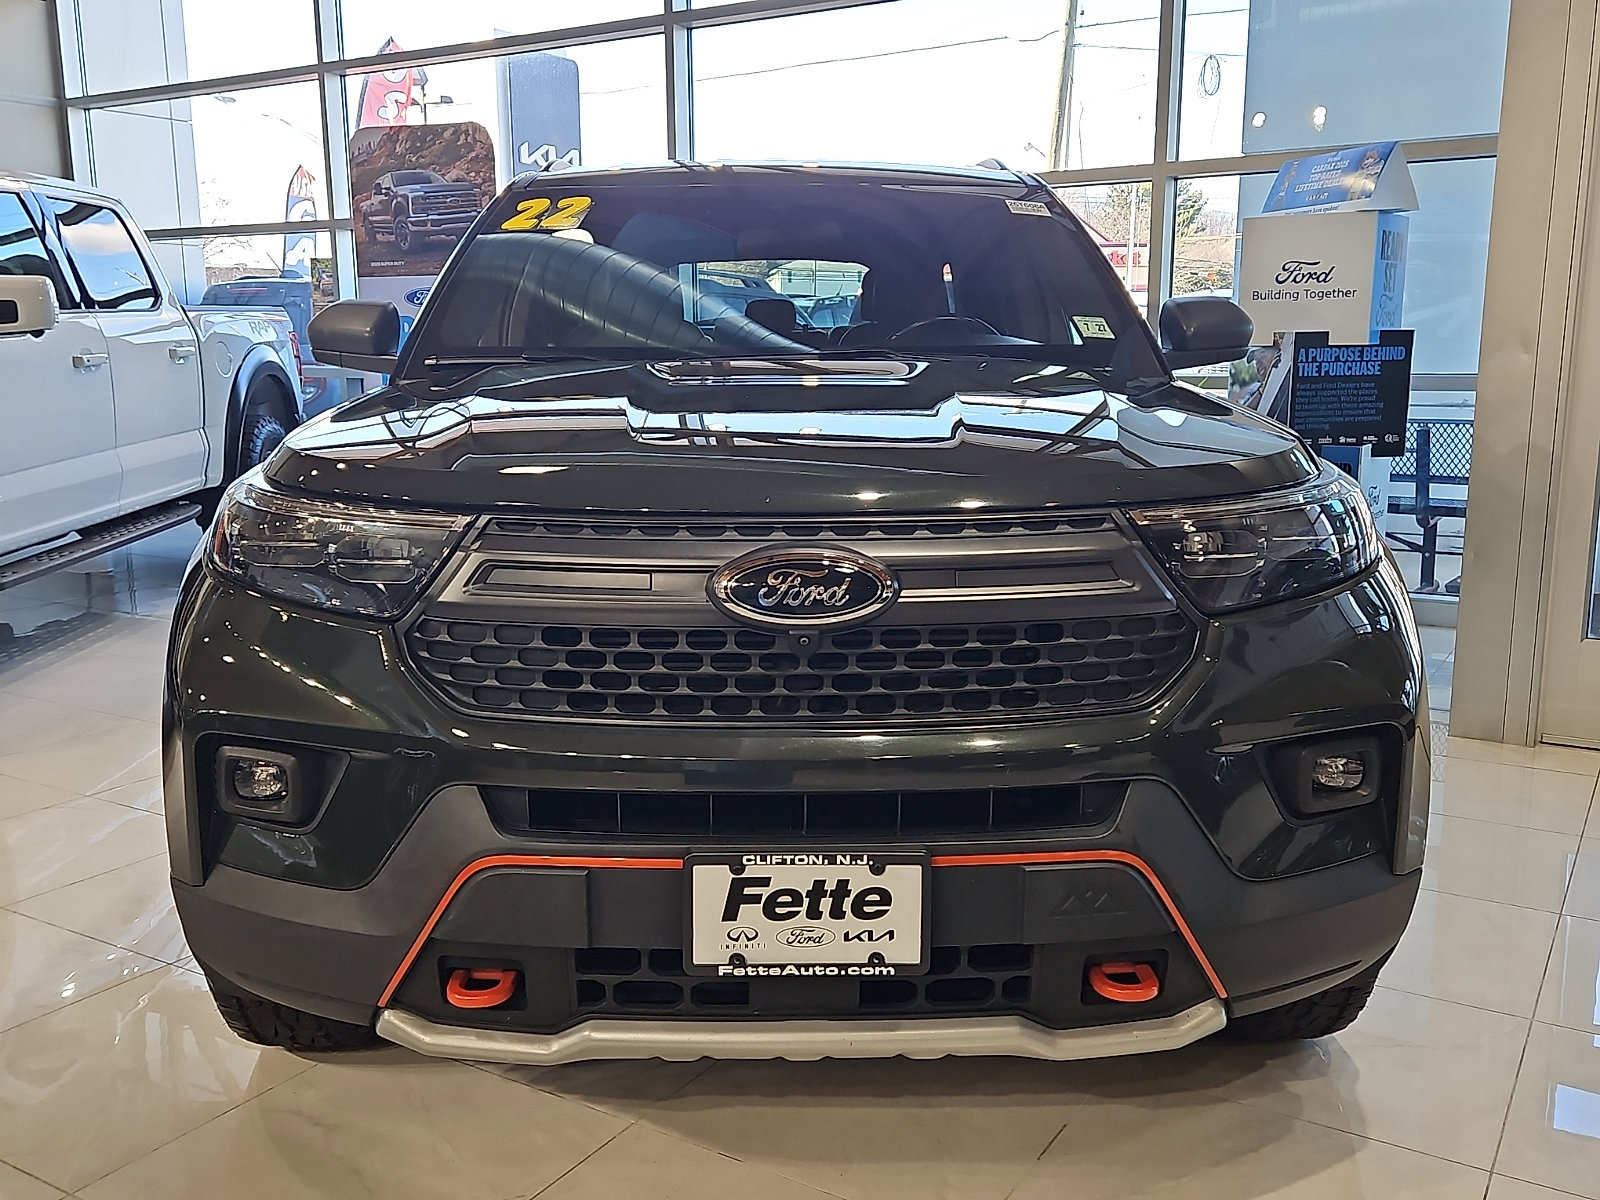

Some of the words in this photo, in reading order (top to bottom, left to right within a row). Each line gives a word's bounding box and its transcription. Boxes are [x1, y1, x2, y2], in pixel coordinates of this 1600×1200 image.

[519, 141, 580, 167] KIA
[500, 195, 592, 230] 22
[1275, 260, 1336, 285] Ford
[1252, 289, 1299, 301] Building
[1303, 288, 1357, 301] Together
[1082, 322, 1090, 331] 7
[1298, 348, 1307, 362] A
[1308, 347, 1361, 361] PURPOSE
[1363, 346, 1406, 360] BEHIND
[1298, 362, 1319, 376] THE
[1321, 361, 1381, 376] PURCHASE
[758, 568, 852, 607] Ford
[742, 854, 829, 866] CLIFTON,
[836, 854, 874, 865] N.J.
[721, 876, 893, 922] Fette
[786, 926, 825, 944] Ford
[843, 929, 895, 943] KIA
[718, 965, 895, 976] FetteAuto.com
